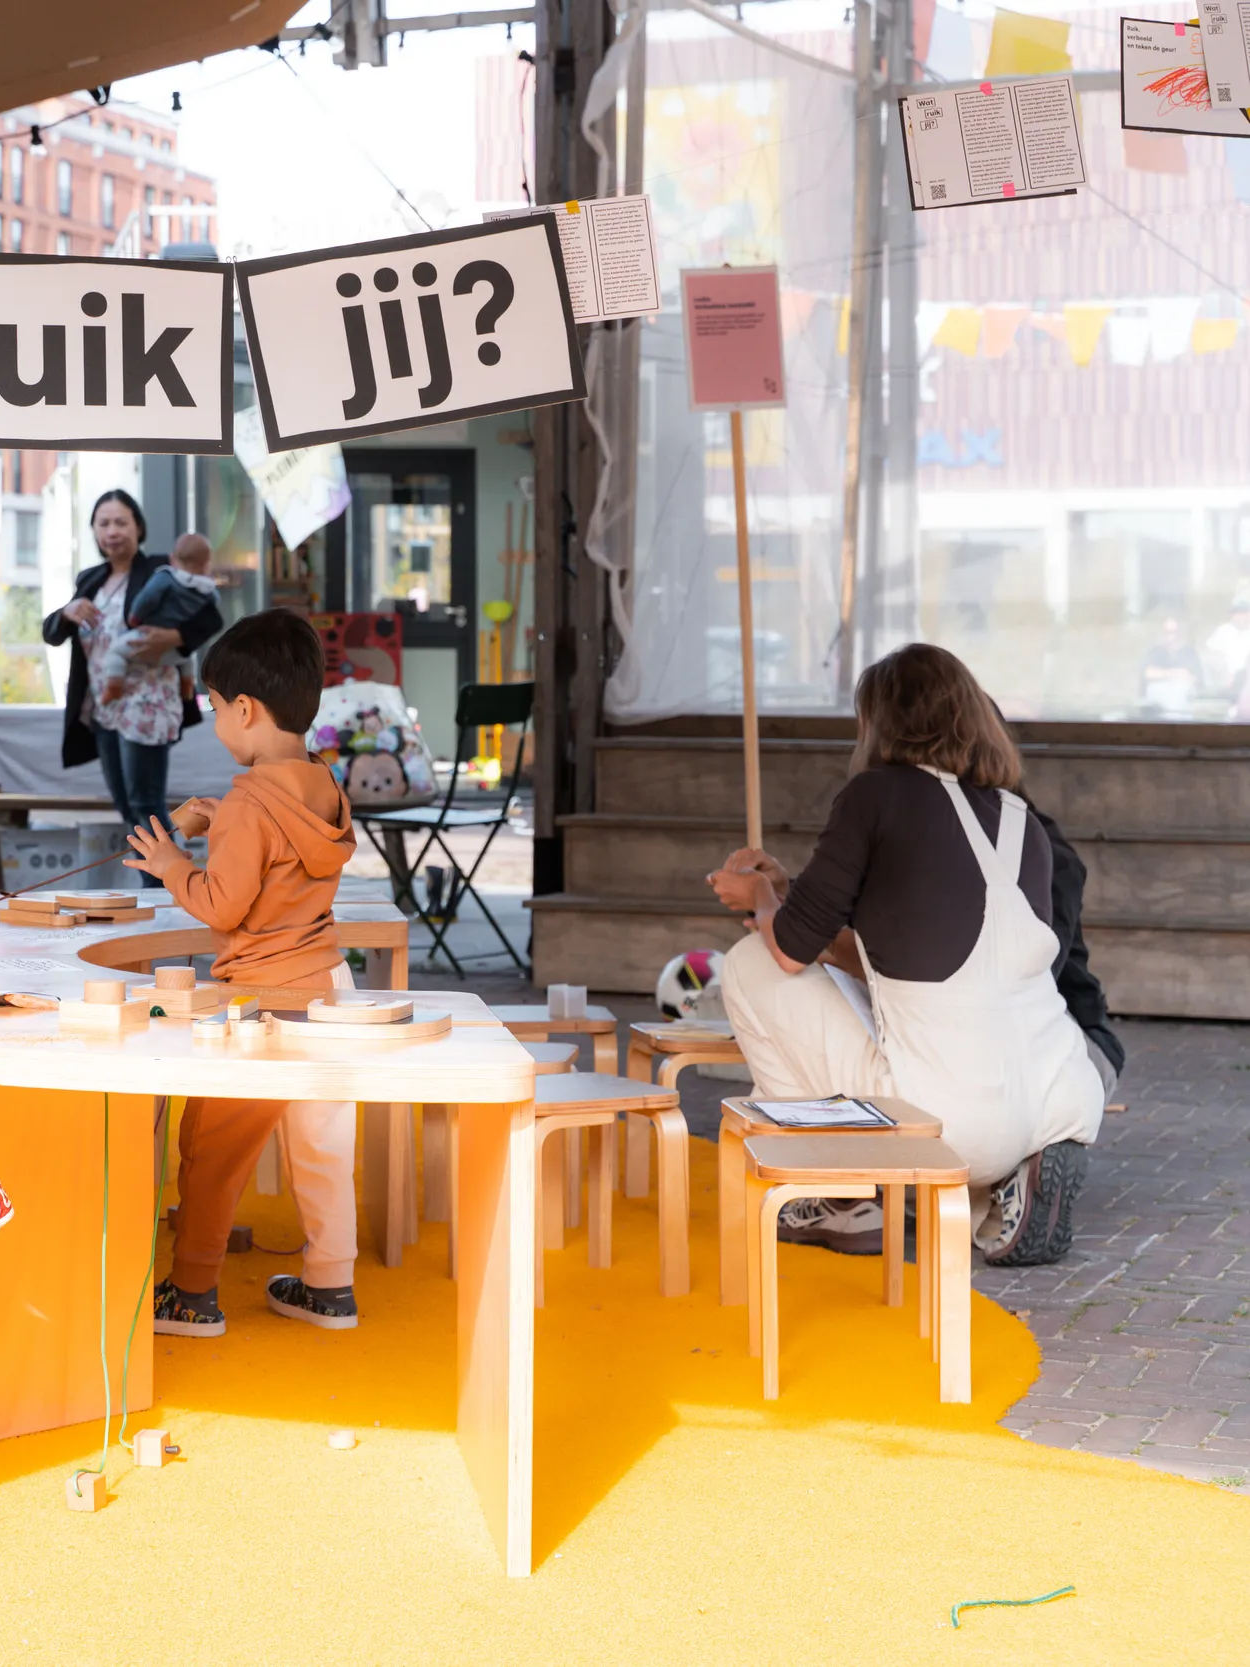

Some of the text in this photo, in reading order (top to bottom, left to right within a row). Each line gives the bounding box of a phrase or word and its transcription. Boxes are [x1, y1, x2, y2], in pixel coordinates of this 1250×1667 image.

[1135, 43, 1152, 51] teken
[918, 99, 934, 107] Wat
[926, 108, 941, 117] ruik
[336, 259, 515, 421] jij?
